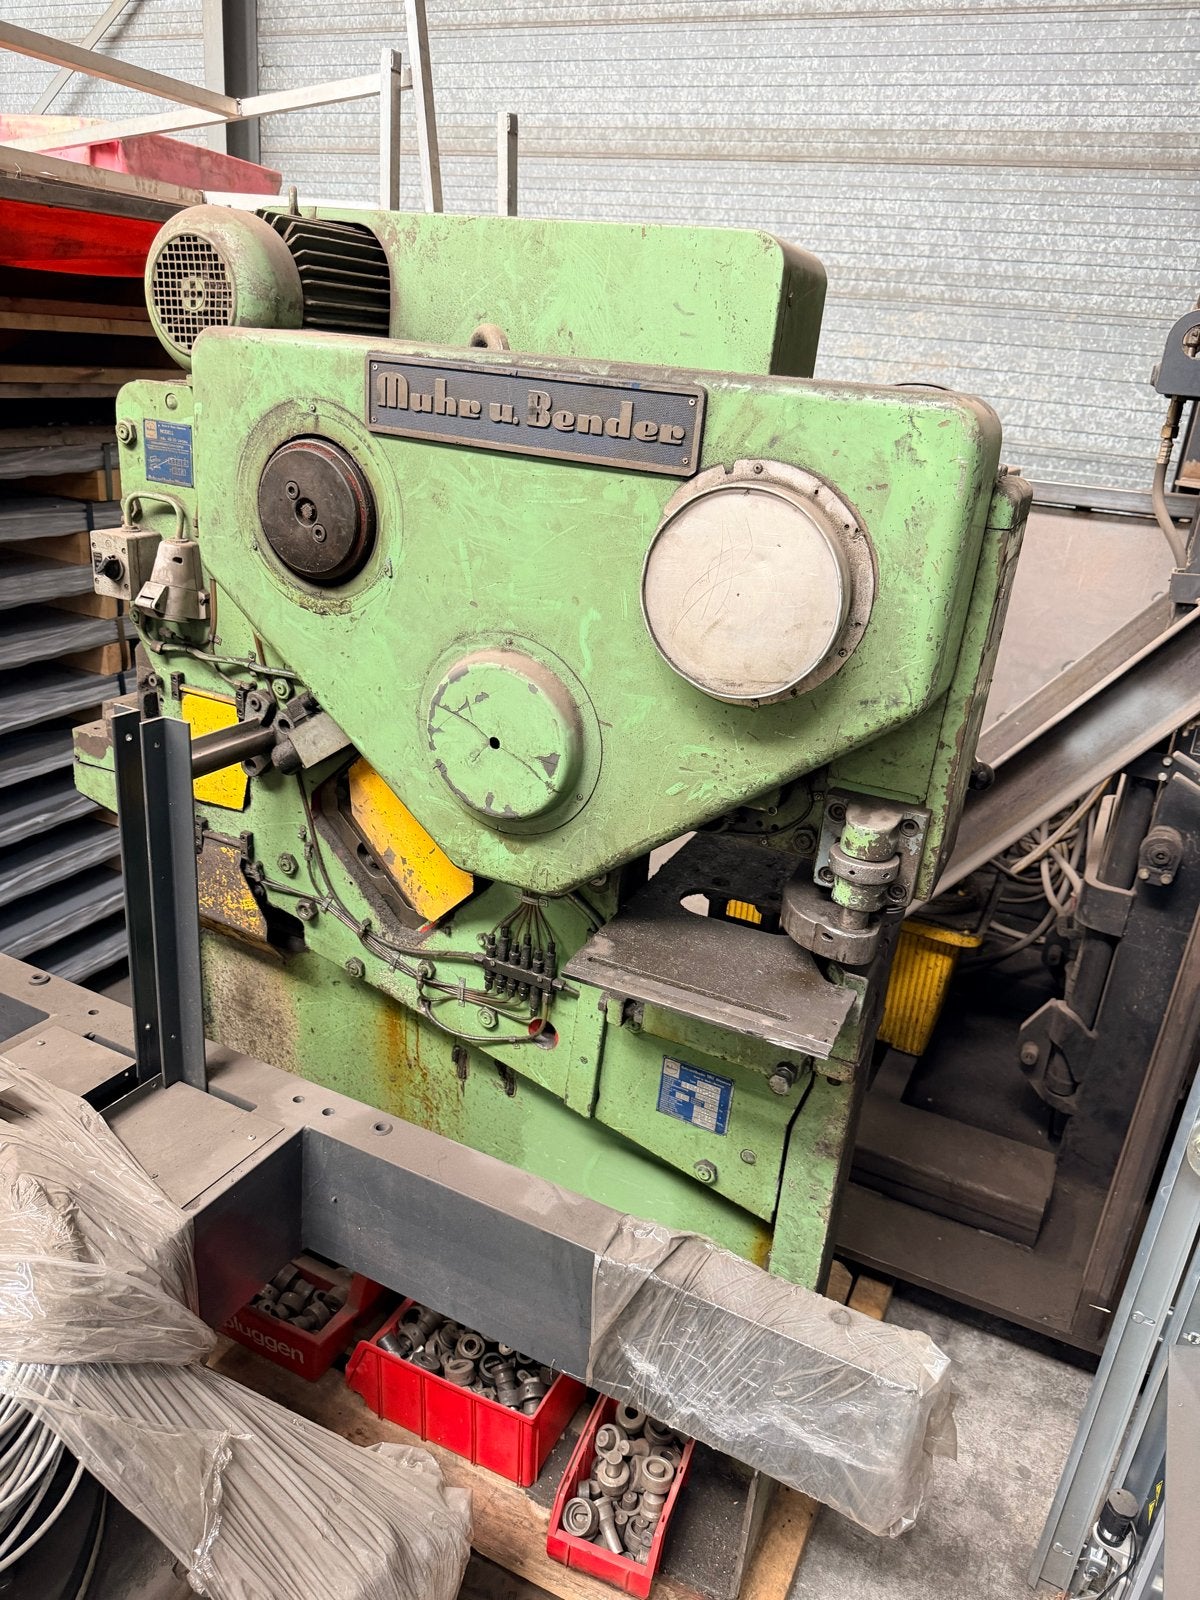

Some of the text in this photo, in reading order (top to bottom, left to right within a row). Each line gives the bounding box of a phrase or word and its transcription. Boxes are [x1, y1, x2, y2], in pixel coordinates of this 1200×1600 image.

[376, 371, 686, 446] Muhr u. Bender
